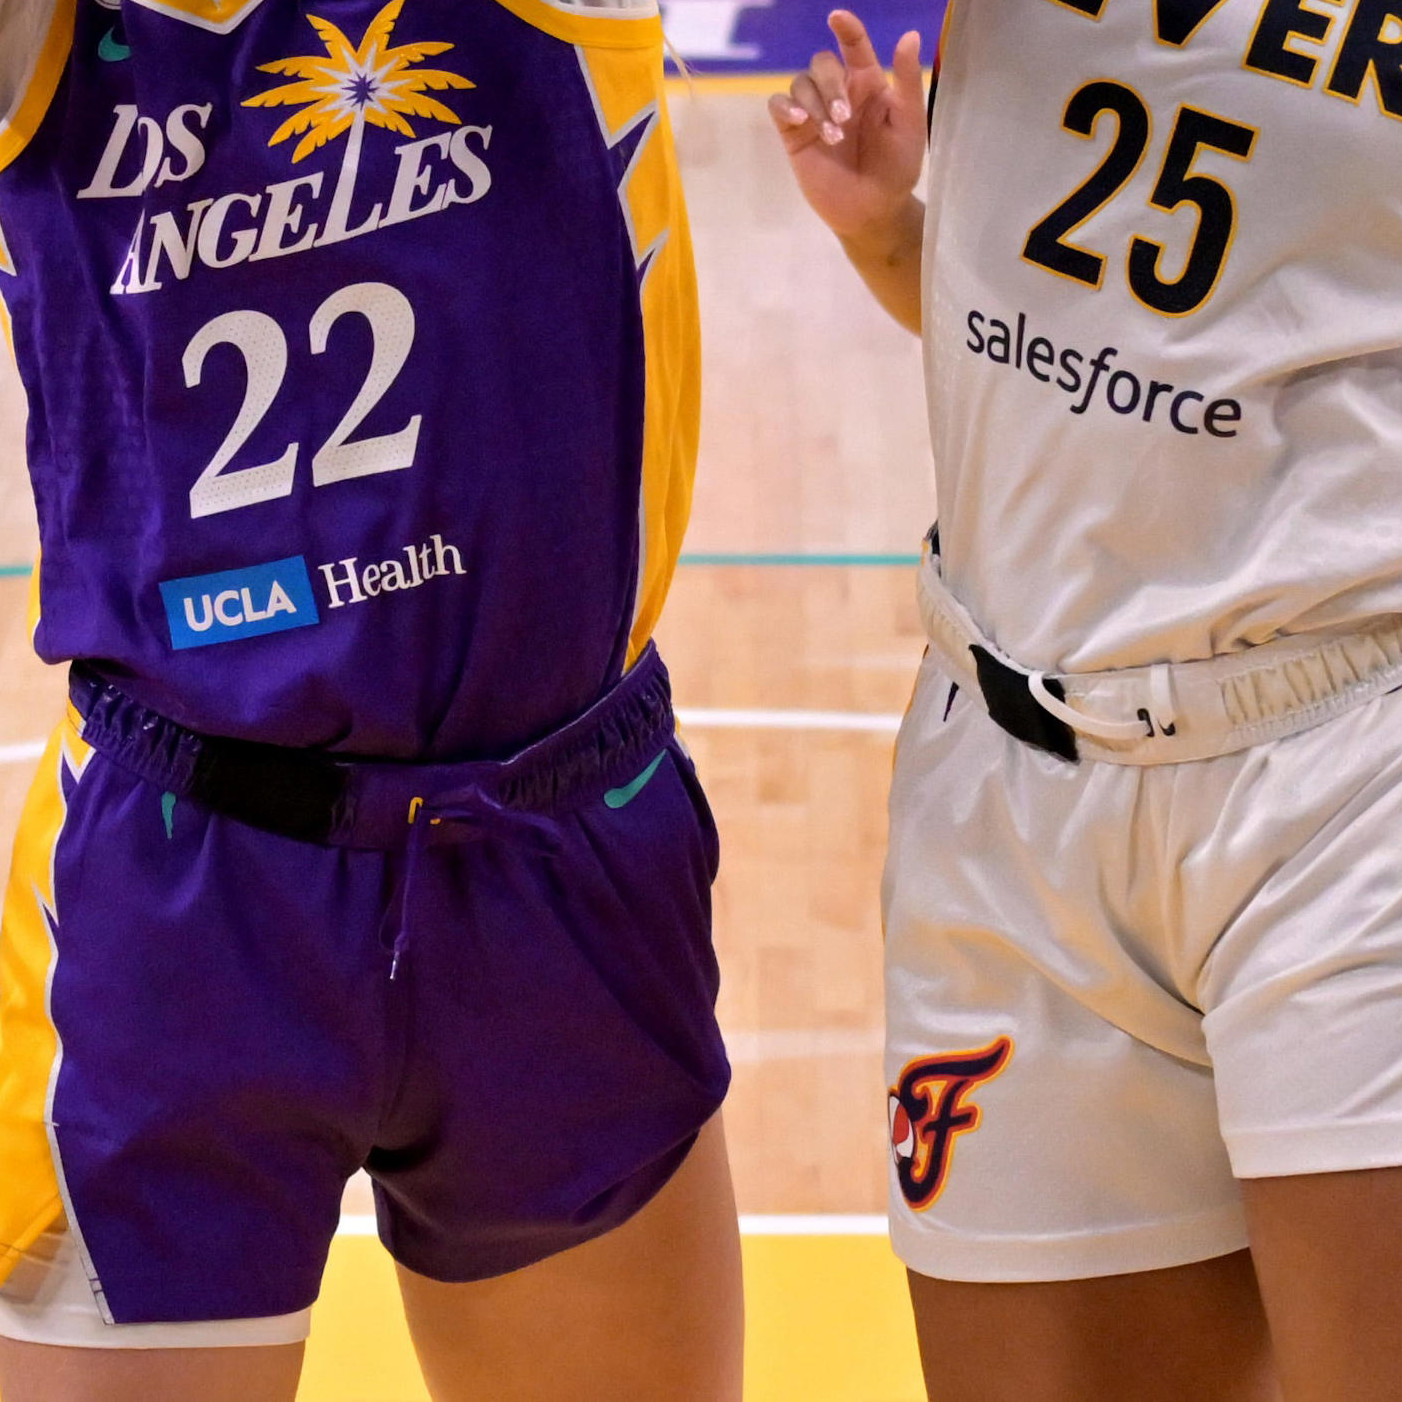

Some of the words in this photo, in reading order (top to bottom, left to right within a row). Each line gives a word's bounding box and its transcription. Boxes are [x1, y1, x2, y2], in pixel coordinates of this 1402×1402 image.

[109, 111, 494, 295] ANGELES
[1020, 78, 1261, 318] 25
[182, 281, 423, 519] 22
[966, 310, 1243, 439] salesforce
[183, 580, 297, 632] UCLA
[318, 534, 467, 609] Health
